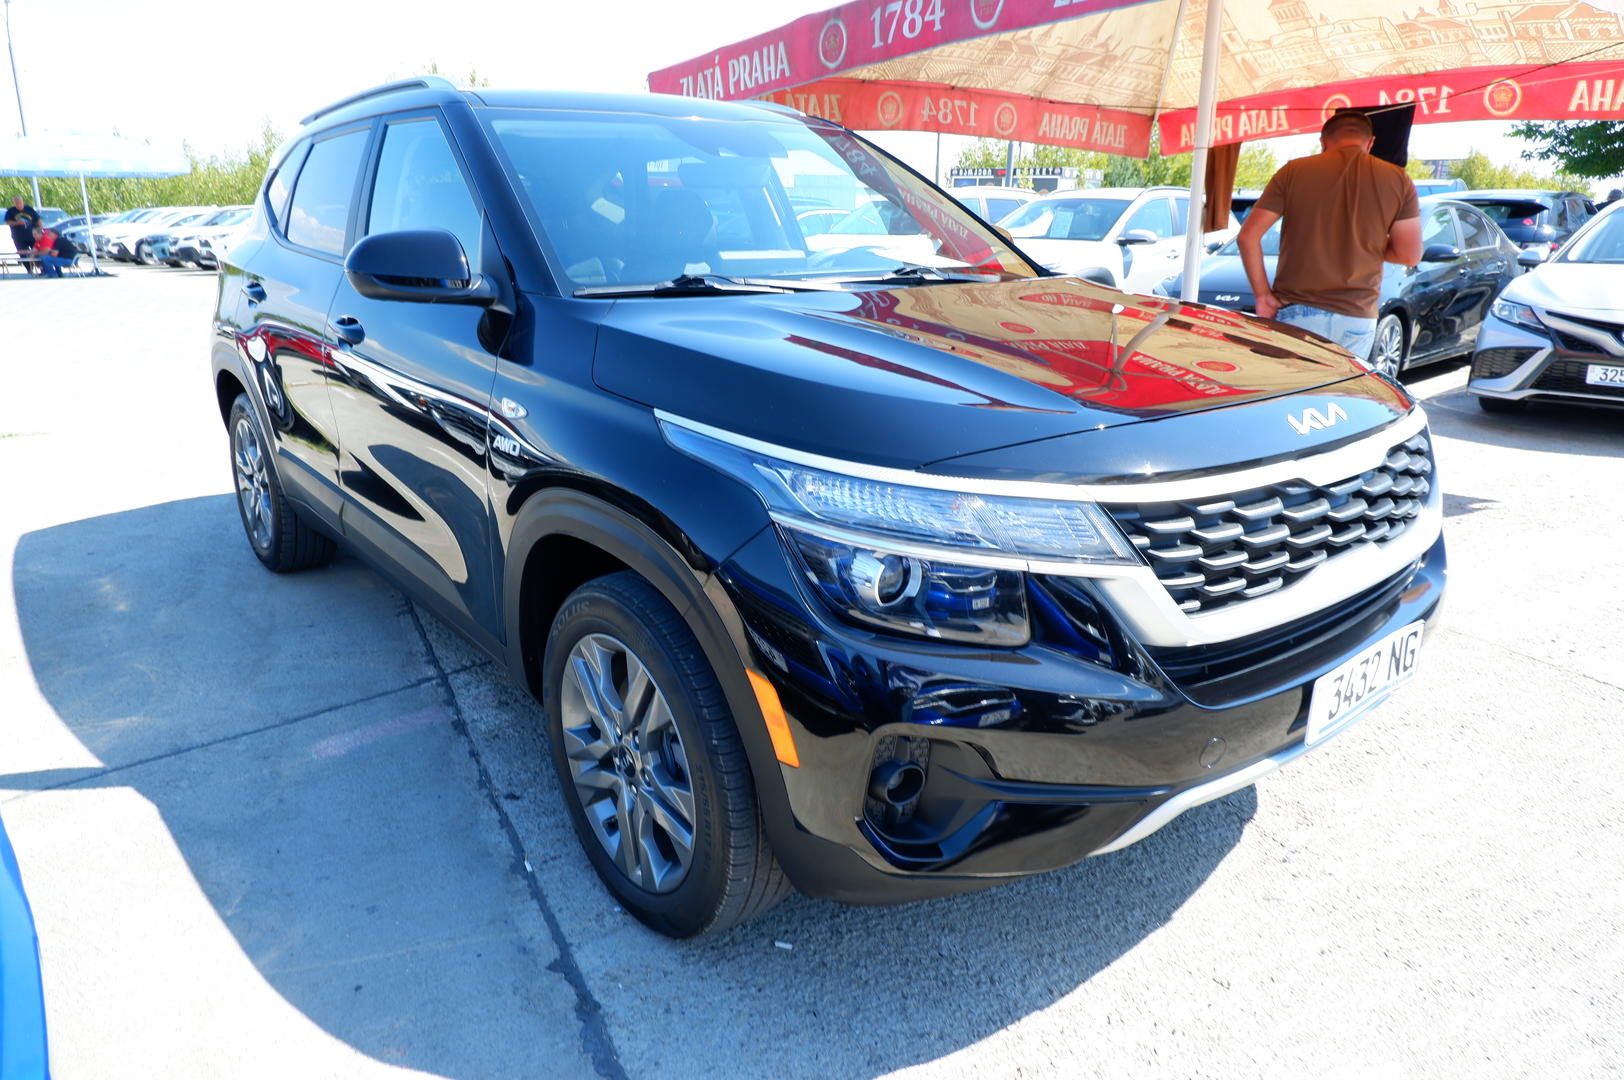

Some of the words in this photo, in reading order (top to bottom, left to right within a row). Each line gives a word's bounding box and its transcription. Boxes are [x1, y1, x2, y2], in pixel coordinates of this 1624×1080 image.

[870, 0, 945, 48] 1784
[728, 40, 790, 95] PRAHA
[493, 434, 520, 457] AWD
[1328, 651, 1382, 720] 3432
[1387, 631, 1418, 681] NG
